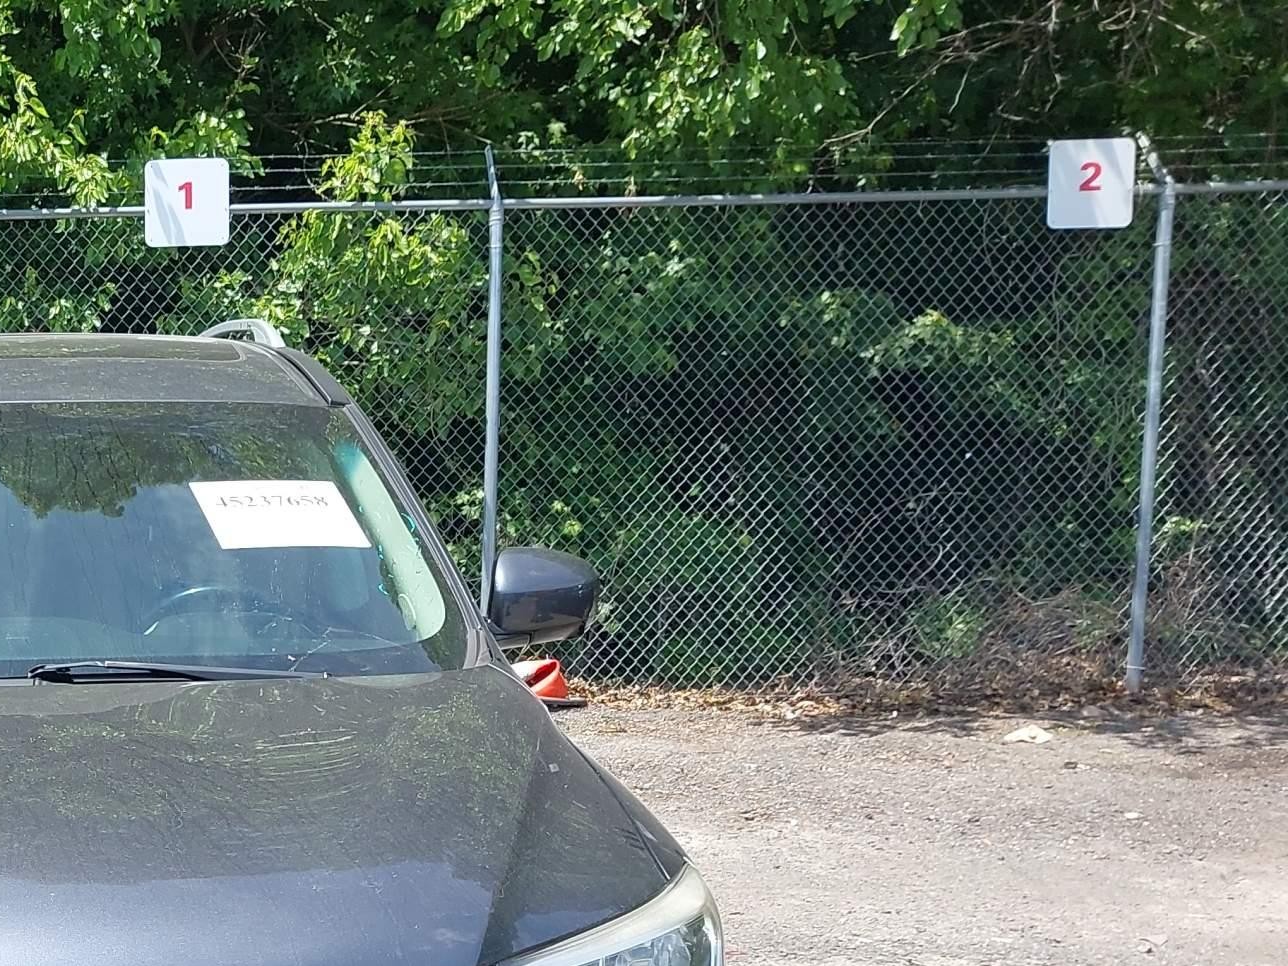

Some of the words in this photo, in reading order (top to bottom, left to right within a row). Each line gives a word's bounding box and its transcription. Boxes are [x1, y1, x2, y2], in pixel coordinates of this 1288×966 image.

[1079, 162, 1102, 192] 2
[178, 181, 193, 210] 1
[216, 495, 329, 508] 45237658
